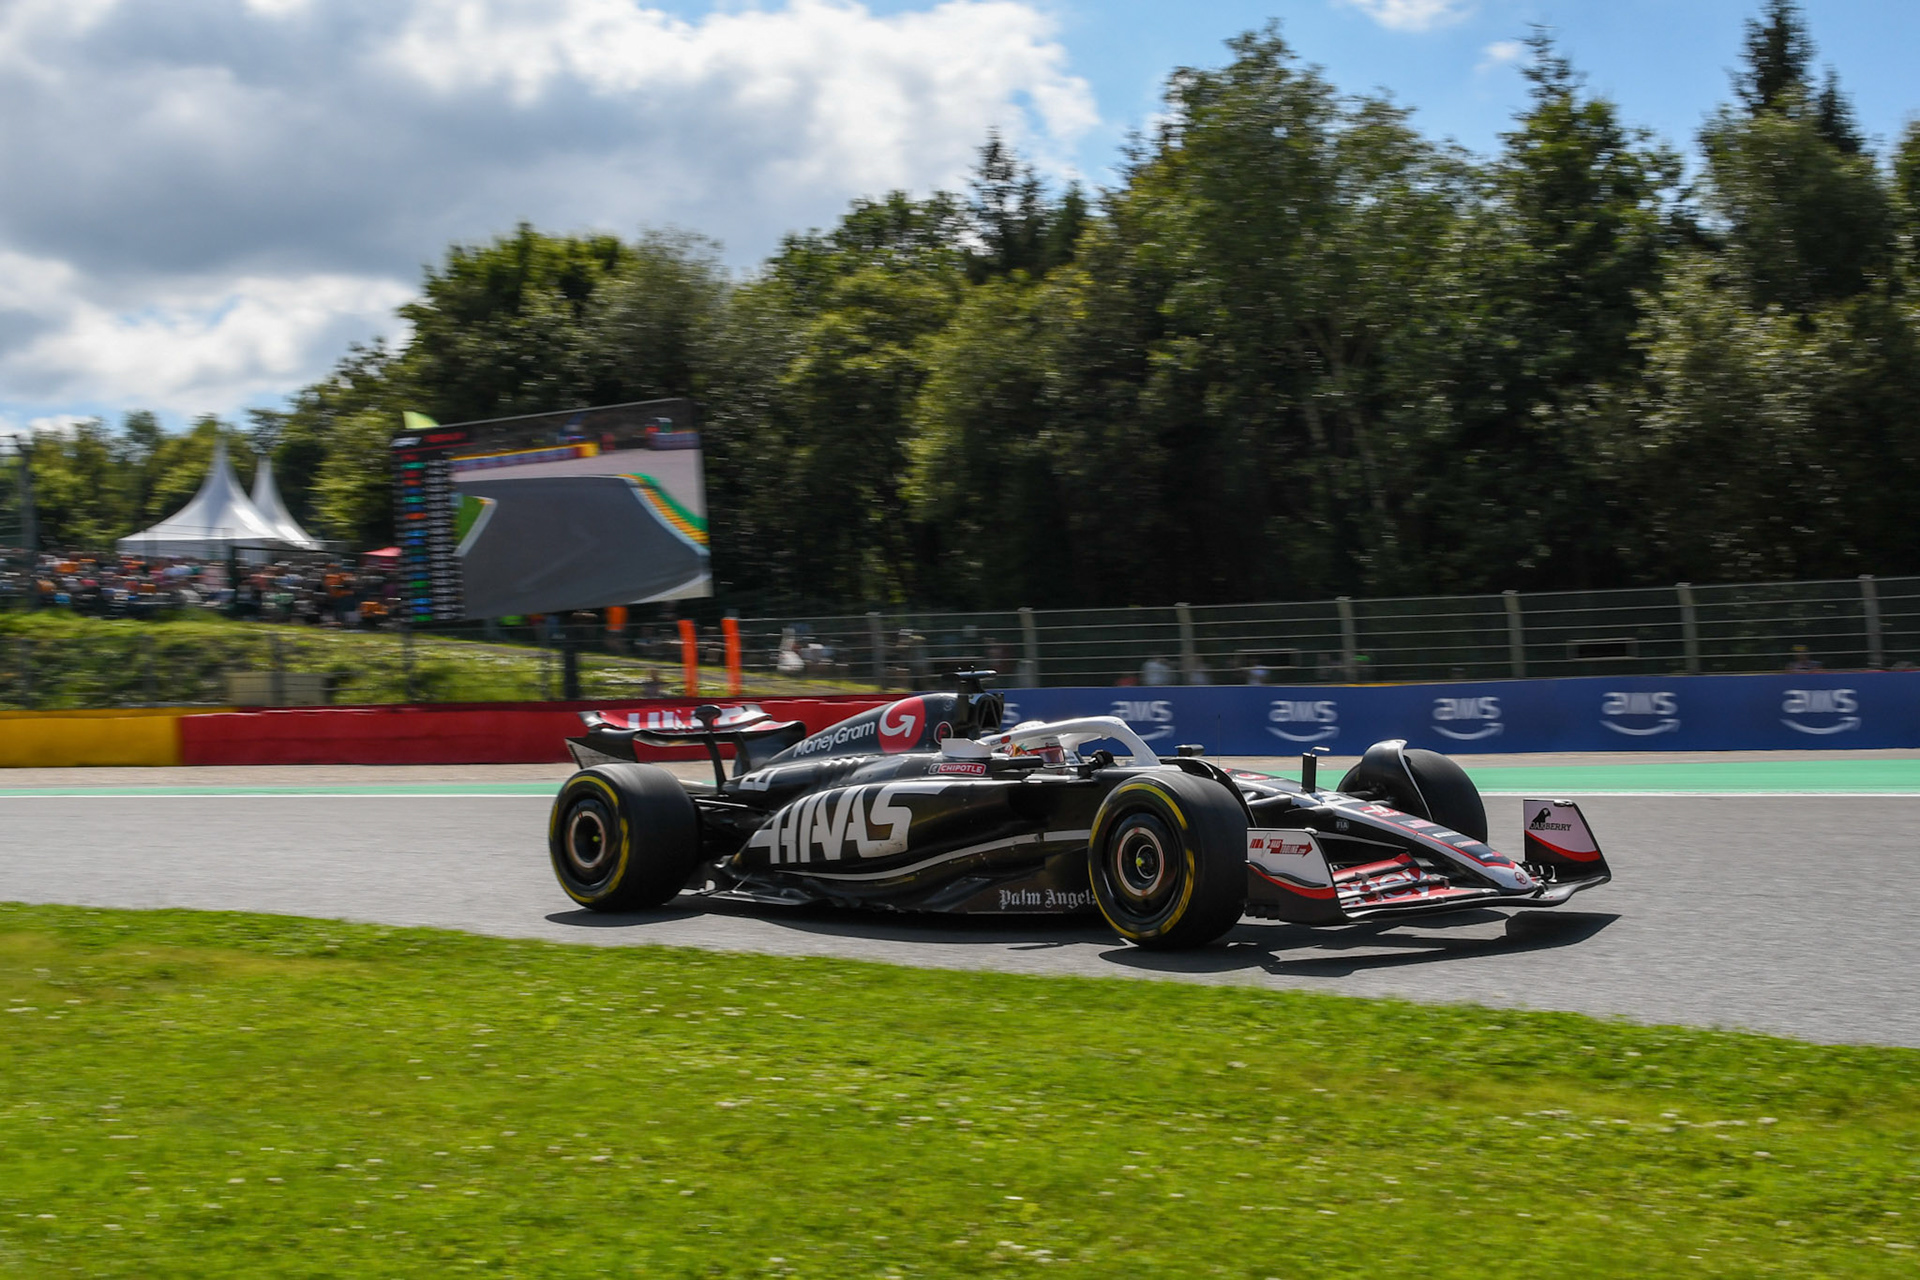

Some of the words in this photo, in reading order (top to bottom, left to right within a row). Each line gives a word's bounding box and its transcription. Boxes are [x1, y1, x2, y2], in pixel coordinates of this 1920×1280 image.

[1110, 700, 1173, 722] aws
[1269, 700, 1338, 723] aws
[1433, 697, 1501, 720] aws
[793, 721, 876, 758] MoneyGram
[940, 764, 983, 774] CHIPOTLE
[749, 782, 949, 864] HAAS
[999, 888, 1041, 910] Palm
